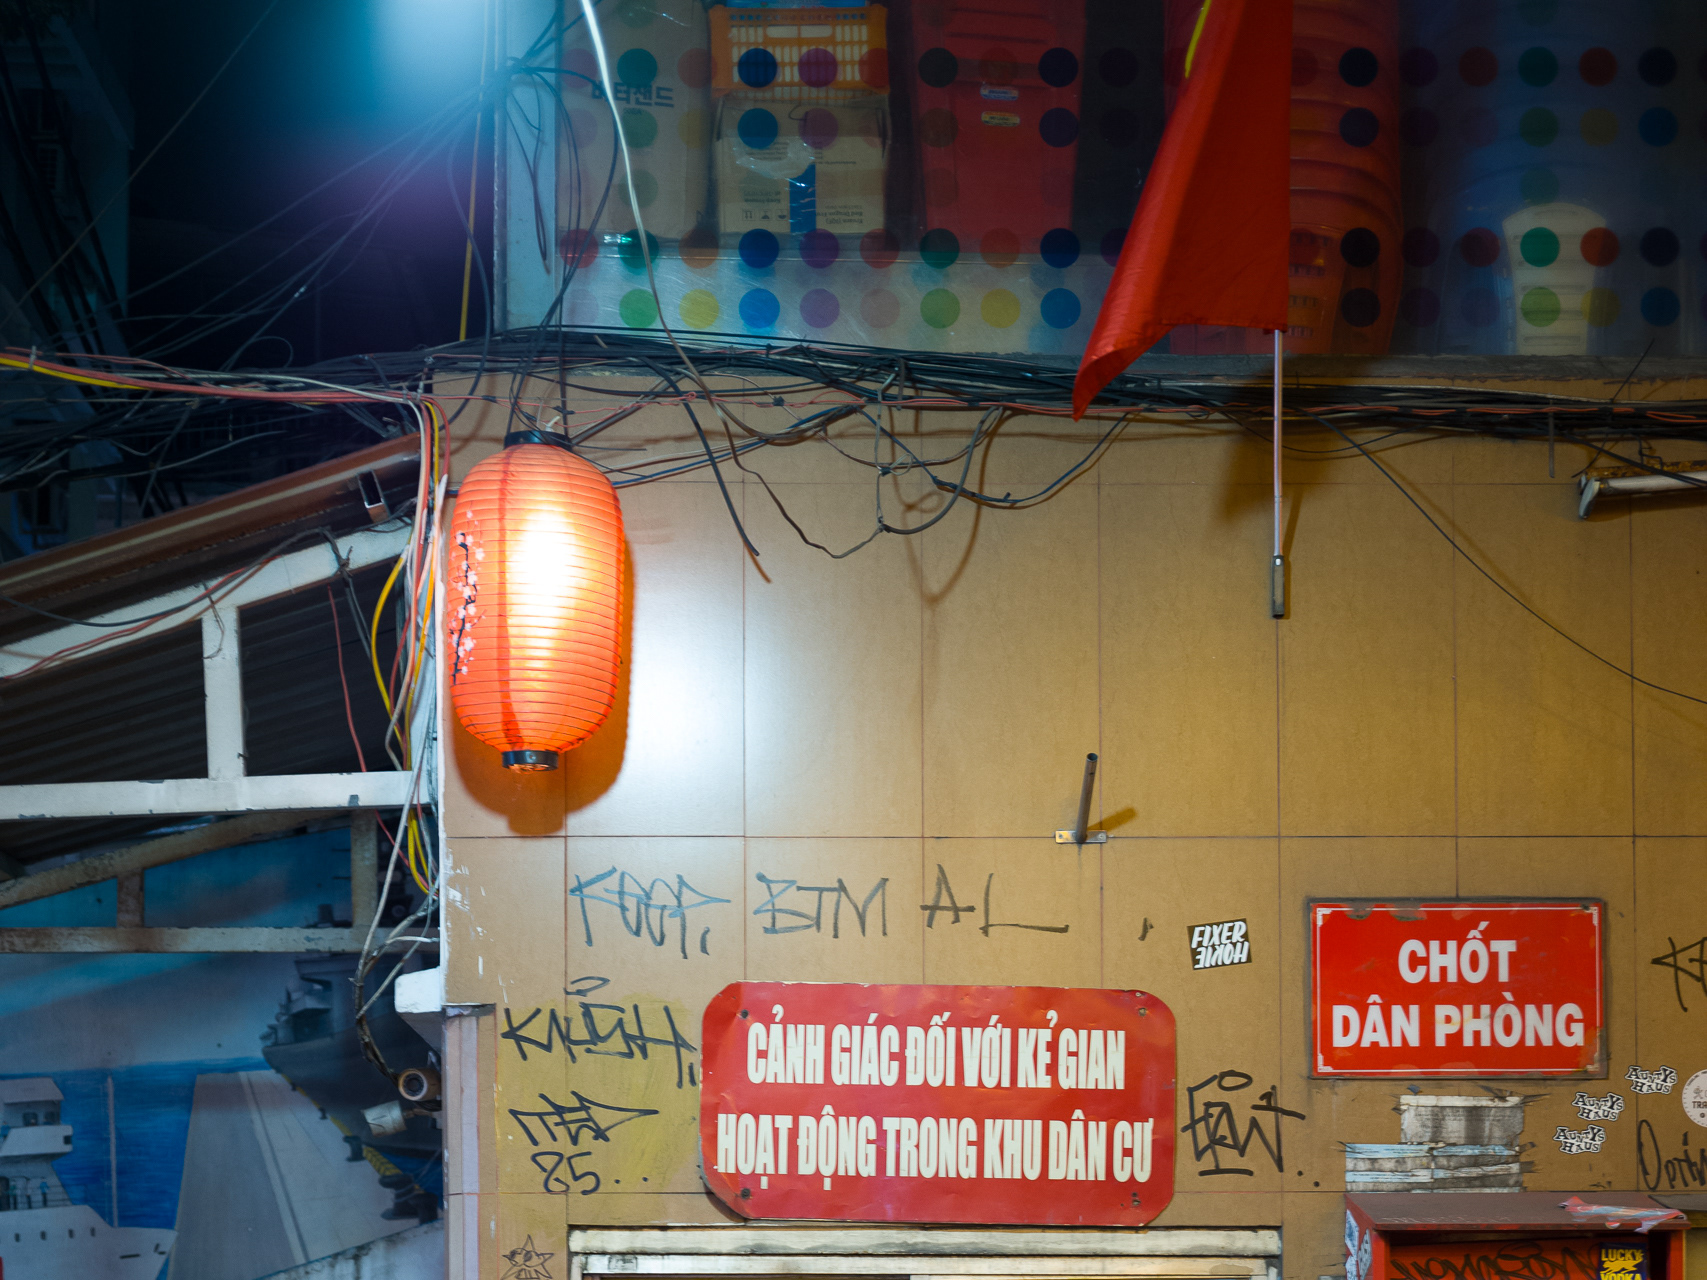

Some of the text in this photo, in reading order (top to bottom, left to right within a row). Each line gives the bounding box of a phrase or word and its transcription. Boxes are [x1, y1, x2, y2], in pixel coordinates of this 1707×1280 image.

[1191, 920, 1247, 949] FIXER
[1398, 921, 1518, 984] CHỐT
[1332, 991, 1585, 1048] DÂN PHÒNG
[746, 1003, 1126, 1090] CẢNH GIÁC ĐỐI VỚI KẺ GIAN
[1632, 1080, 1672, 1094] HAUS
[1579, 1107, 1618, 1121] HAUS
[714, 1112, 794, 1190] HOẠT
[796, 1104, 878, 1192] ĐỘNG
[882, 1115, 978, 1180] TRONG
[983, 1118, 1043, 1181] KHU
[1047, 1109, 1107, 1181] DÂN
[1112, 1115, 1155, 1183] CƯ
[1560, 1140, 1600, 1153] HAUS
[1601, 1248, 1643, 1262] LUCKY
